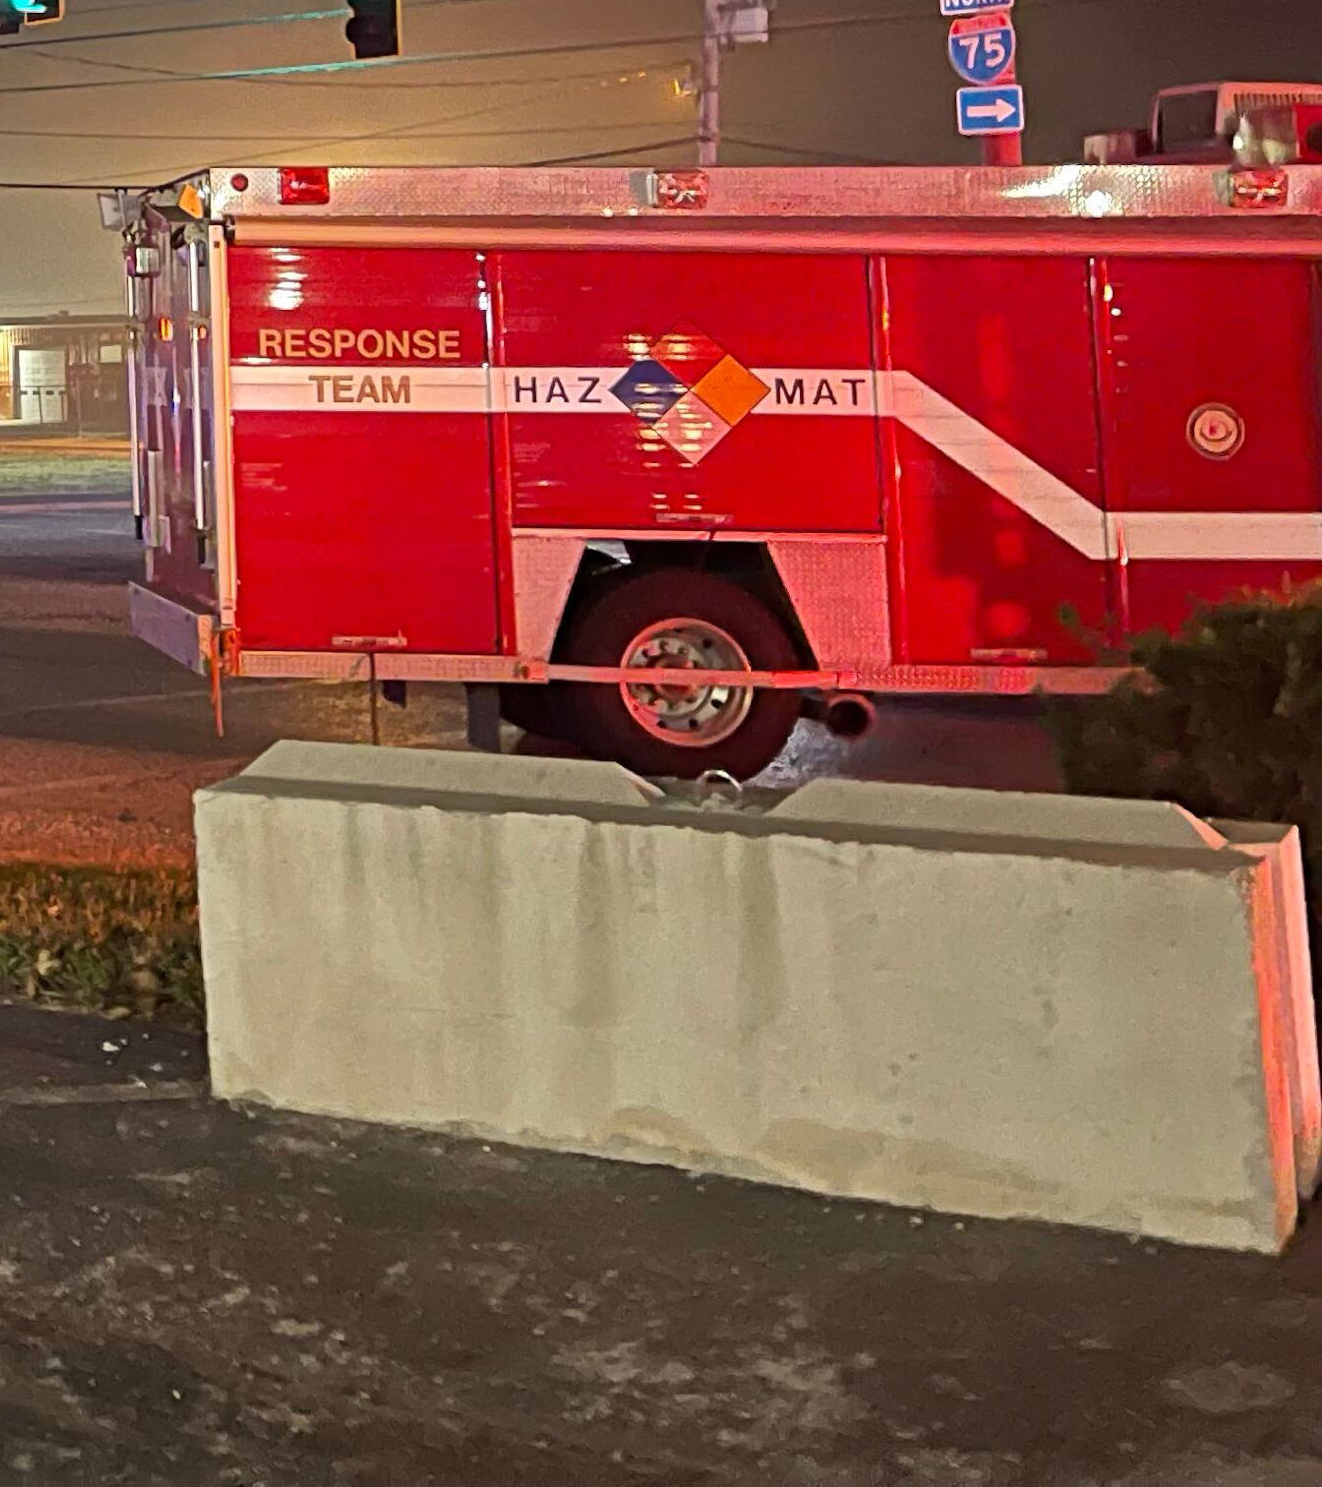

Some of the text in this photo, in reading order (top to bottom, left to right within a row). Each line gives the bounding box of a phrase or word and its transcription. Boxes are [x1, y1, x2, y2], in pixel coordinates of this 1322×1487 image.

[958, 32, 1005, 70] 75
[259, 328, 461, 359] RESPONSE
[308, 375, 411, 404] TEAM
[514, 375, 866, 406] HAZ MAT
